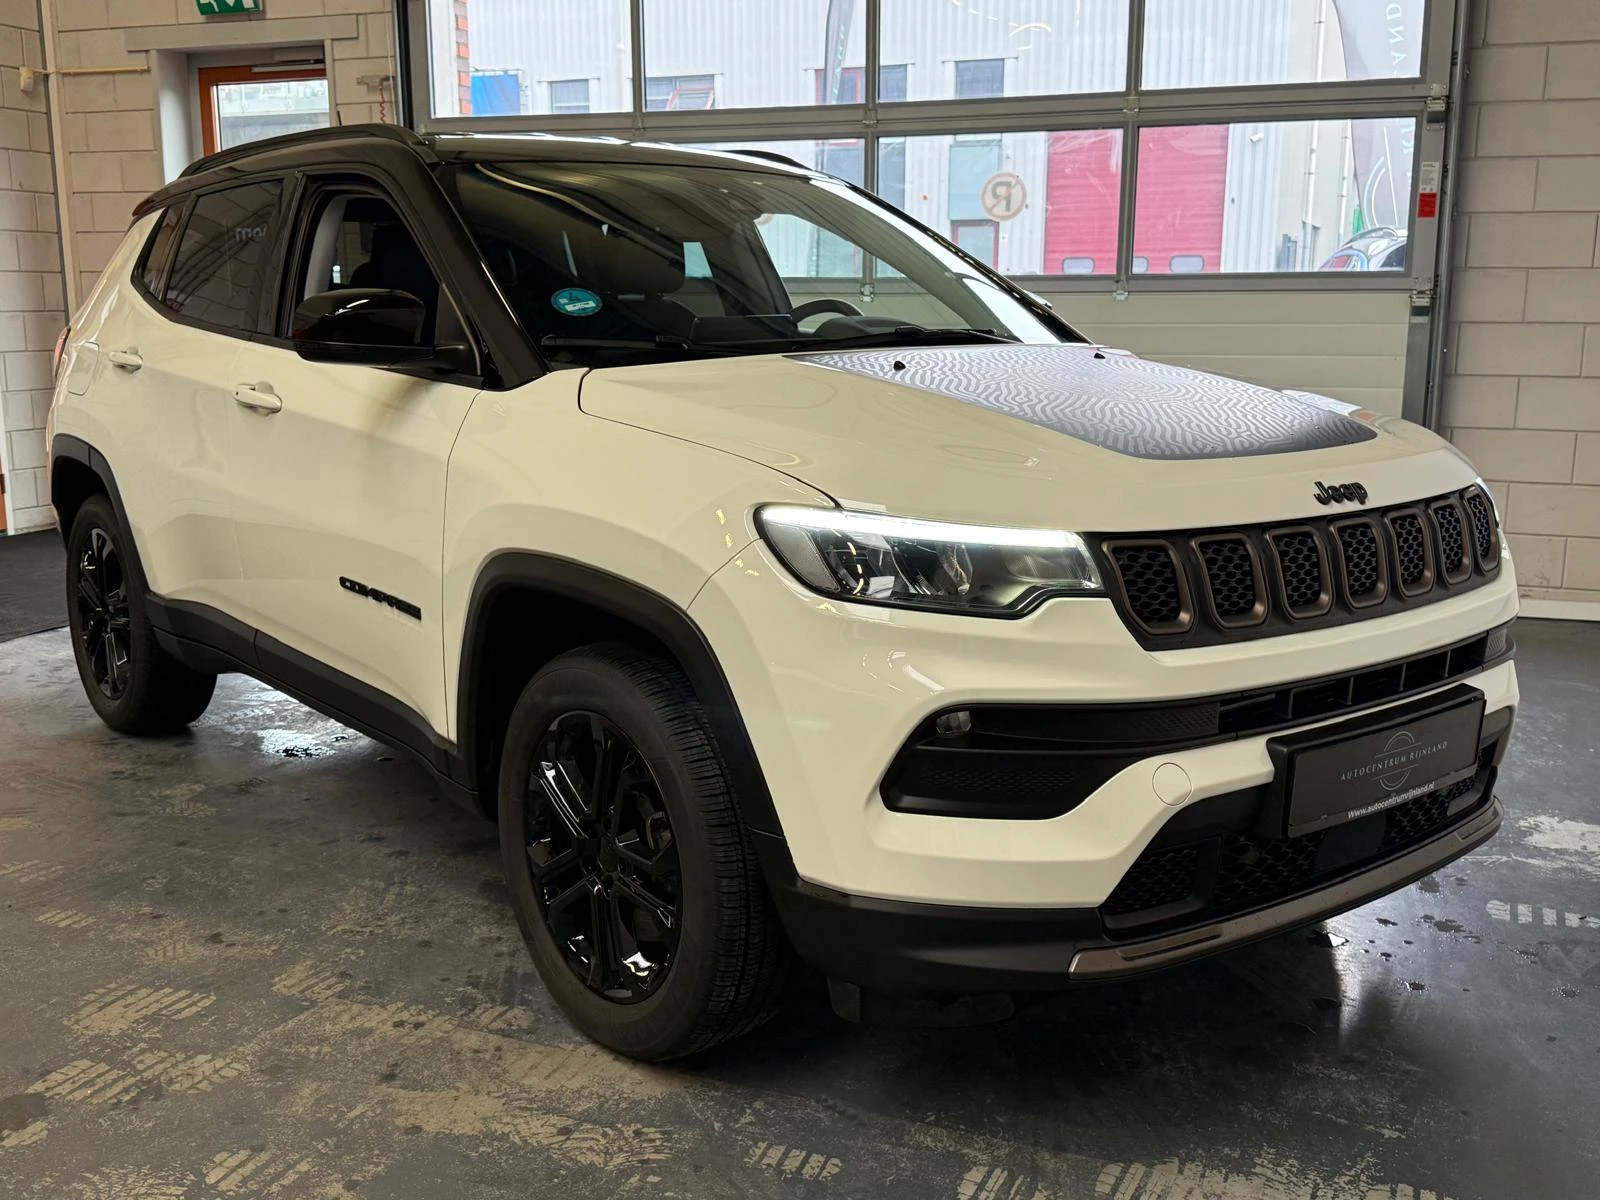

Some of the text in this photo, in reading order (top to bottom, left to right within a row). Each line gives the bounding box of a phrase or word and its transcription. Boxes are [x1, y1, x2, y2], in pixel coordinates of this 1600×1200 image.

[1313, 480, 1368, 505] Jeep
[1340, 741, 1448, 781] AUTOCENTRUM RIJNLAND
